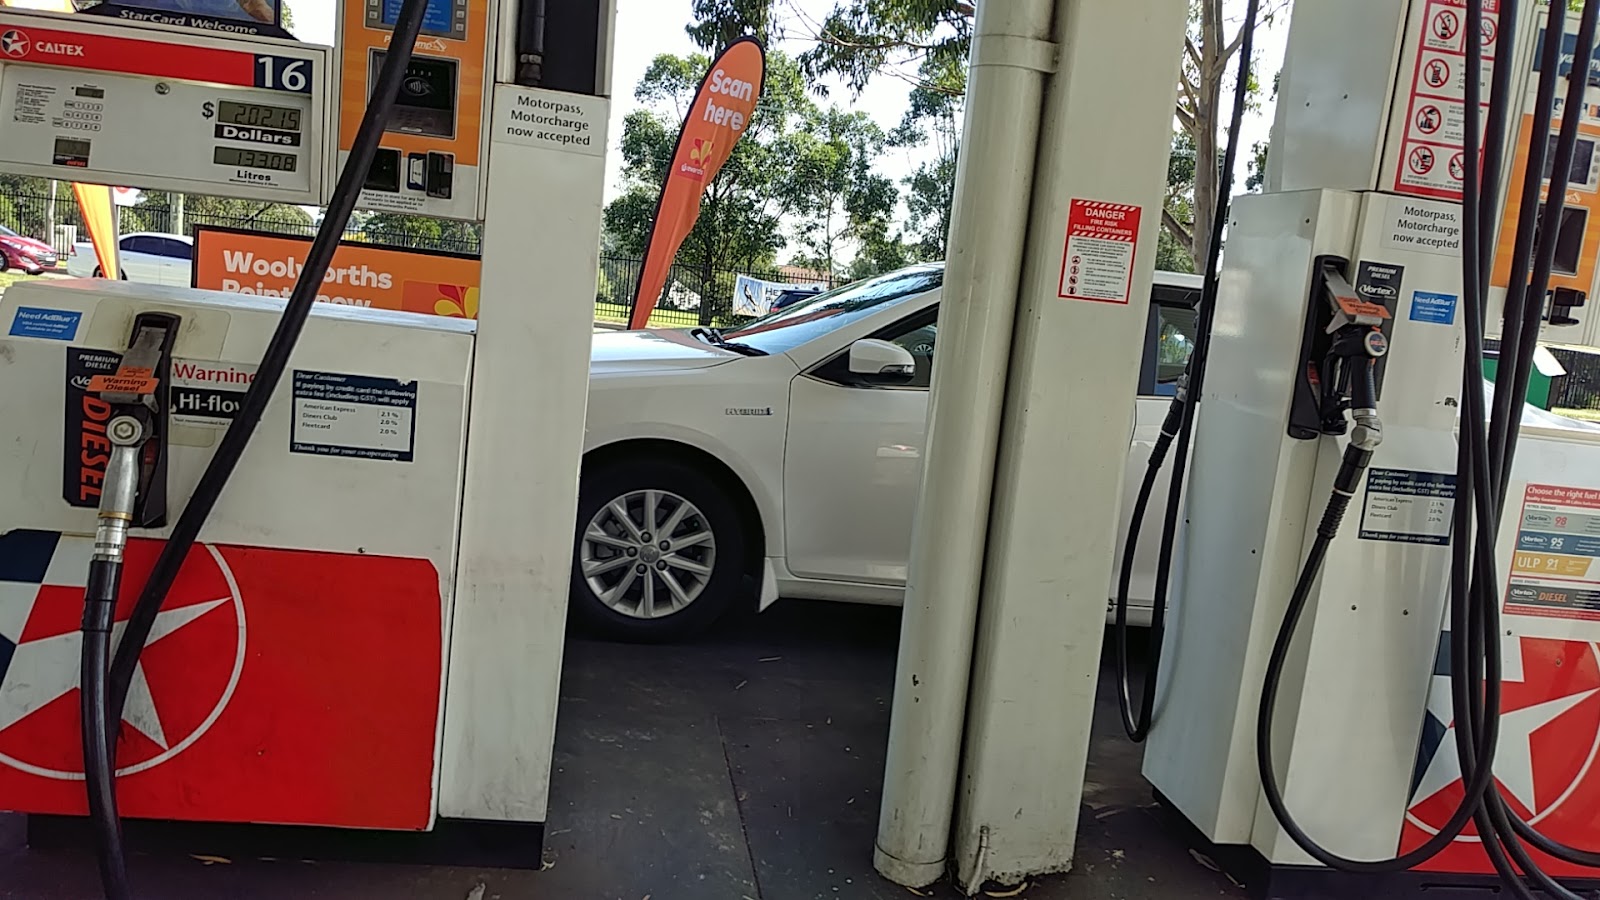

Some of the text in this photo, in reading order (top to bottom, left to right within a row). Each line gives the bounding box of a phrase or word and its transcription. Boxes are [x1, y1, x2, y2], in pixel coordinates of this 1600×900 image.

[119, 9, 258, 35] StarCard Welcome
[35, 41, 84, 57] CALTEX
[258, 56, 306, 91] 16
[709, 69, 752, 101] Scan
[202, 101, 215, 120] $
[518, 95, 584, 116] Motorpass,
[510, 110, 589, 132] Motorcharge
[703, 98, 744, 130] here
[223, 126, 292, 144] Dollars
[507, 126, 591, 146] now accepted
[237, 170, 271, 181] Litres
[1085, 207, 1126, 221] DANGER
[1404, 206, 1457, 222] Motorpass,
[1073, 224, 1133, 236] FILLING CONTAINERS
[1397, 219, 1460, 237] Motorcharge
[1393, 233, 1459, 249] now accepted
[1367, 265, 1397, 275] PREMIUM
[1362, 284, 1393, 295] Vortex
[18, 311, 41, 320] Need
[79, 354, 119, 364] PREMIUM
[85, 361, 112, 370] DIESEL
[103, 376, 148, 387] Warning
[296, 371, 347, 382] Dear Customer
[105, 384, 140, 392] Diesel
[302, 382, 325, 390] paying
[384, 389, 416, 399] following
[303, 403, 333, 411] American
[360, 394, 377, 402] GST)
[391, 398, 410, 406] apply
[80, 395, 111, 500] DIESEL
[357, 450, 399, 459] co-operation
[1527, 486, 1553, 496] Choose
[1566, 490, 1583, 500] right
[1584, 491, 1597, 499] fuel
[1555, 516, 1567, 526] 98
[1550, 537, 1564, 547] 95
[1517, 556, 1541, 568] ULP
[1546, 557, 1560, 568] 91
[1513, 588, 1534, 596] Vortex
[1538, 591, 1568, 602] DIESEL
